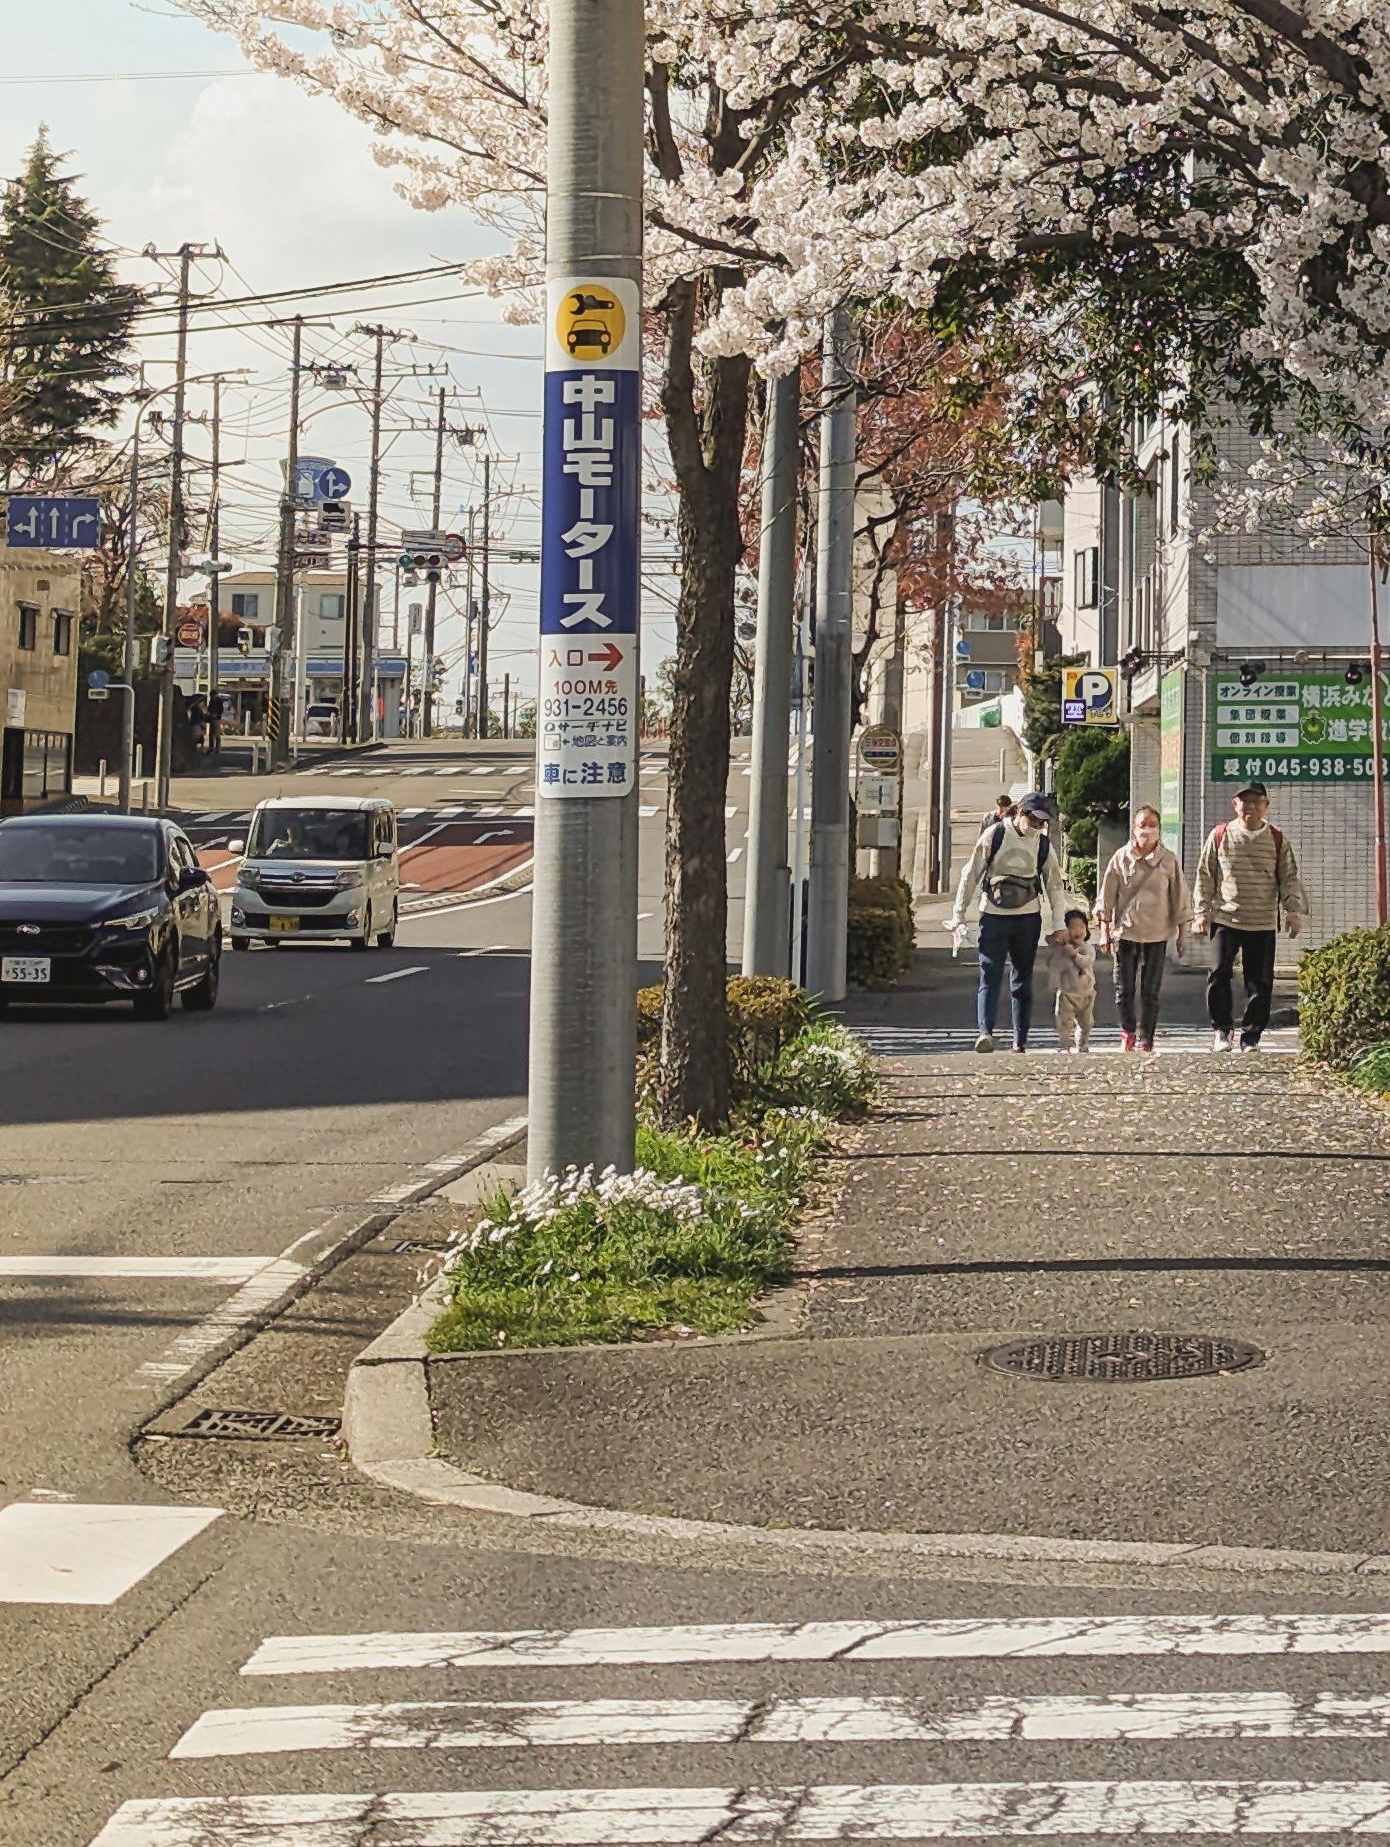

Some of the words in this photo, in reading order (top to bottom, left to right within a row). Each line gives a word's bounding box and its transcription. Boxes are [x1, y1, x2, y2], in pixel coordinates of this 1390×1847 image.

[560, 374, 616, 629] 中山モータース
[548, 649, 584, 667] 入口
[553, 679, 618, 695] 100M先
[1082, 674, 1109, 707] P
[544, 697, 628, 717] 931-2456
[543, 761, 627, 785] 車に注意
[1223, 757, 1262, 776] 受付
